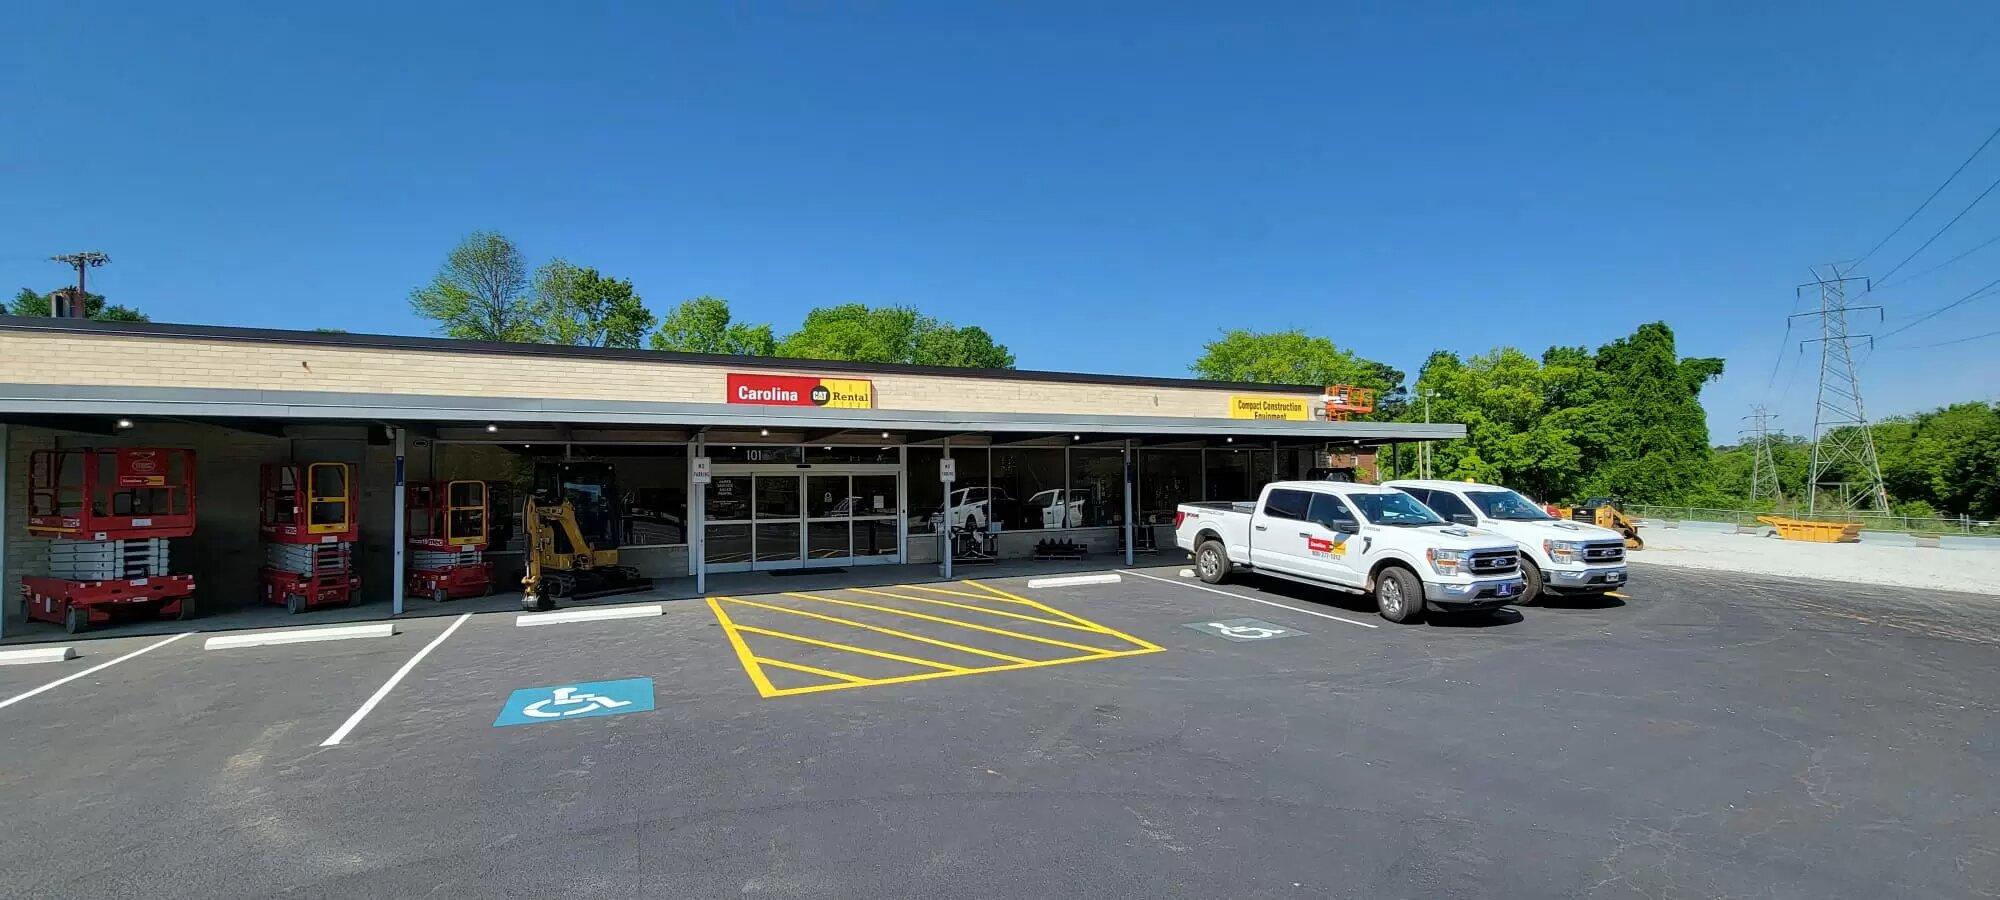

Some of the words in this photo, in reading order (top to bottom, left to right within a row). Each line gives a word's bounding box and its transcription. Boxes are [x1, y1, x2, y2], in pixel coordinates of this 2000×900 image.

[738, 385, 798, 402] Carolina
[812, 391, 828, 401] CAT
[833, 392, 869, 402] Rental
[1238, 399, 1262, 412] Compact
[1263, 400, 1302, 412] Construction
[746, 450, 762, 461] 101
